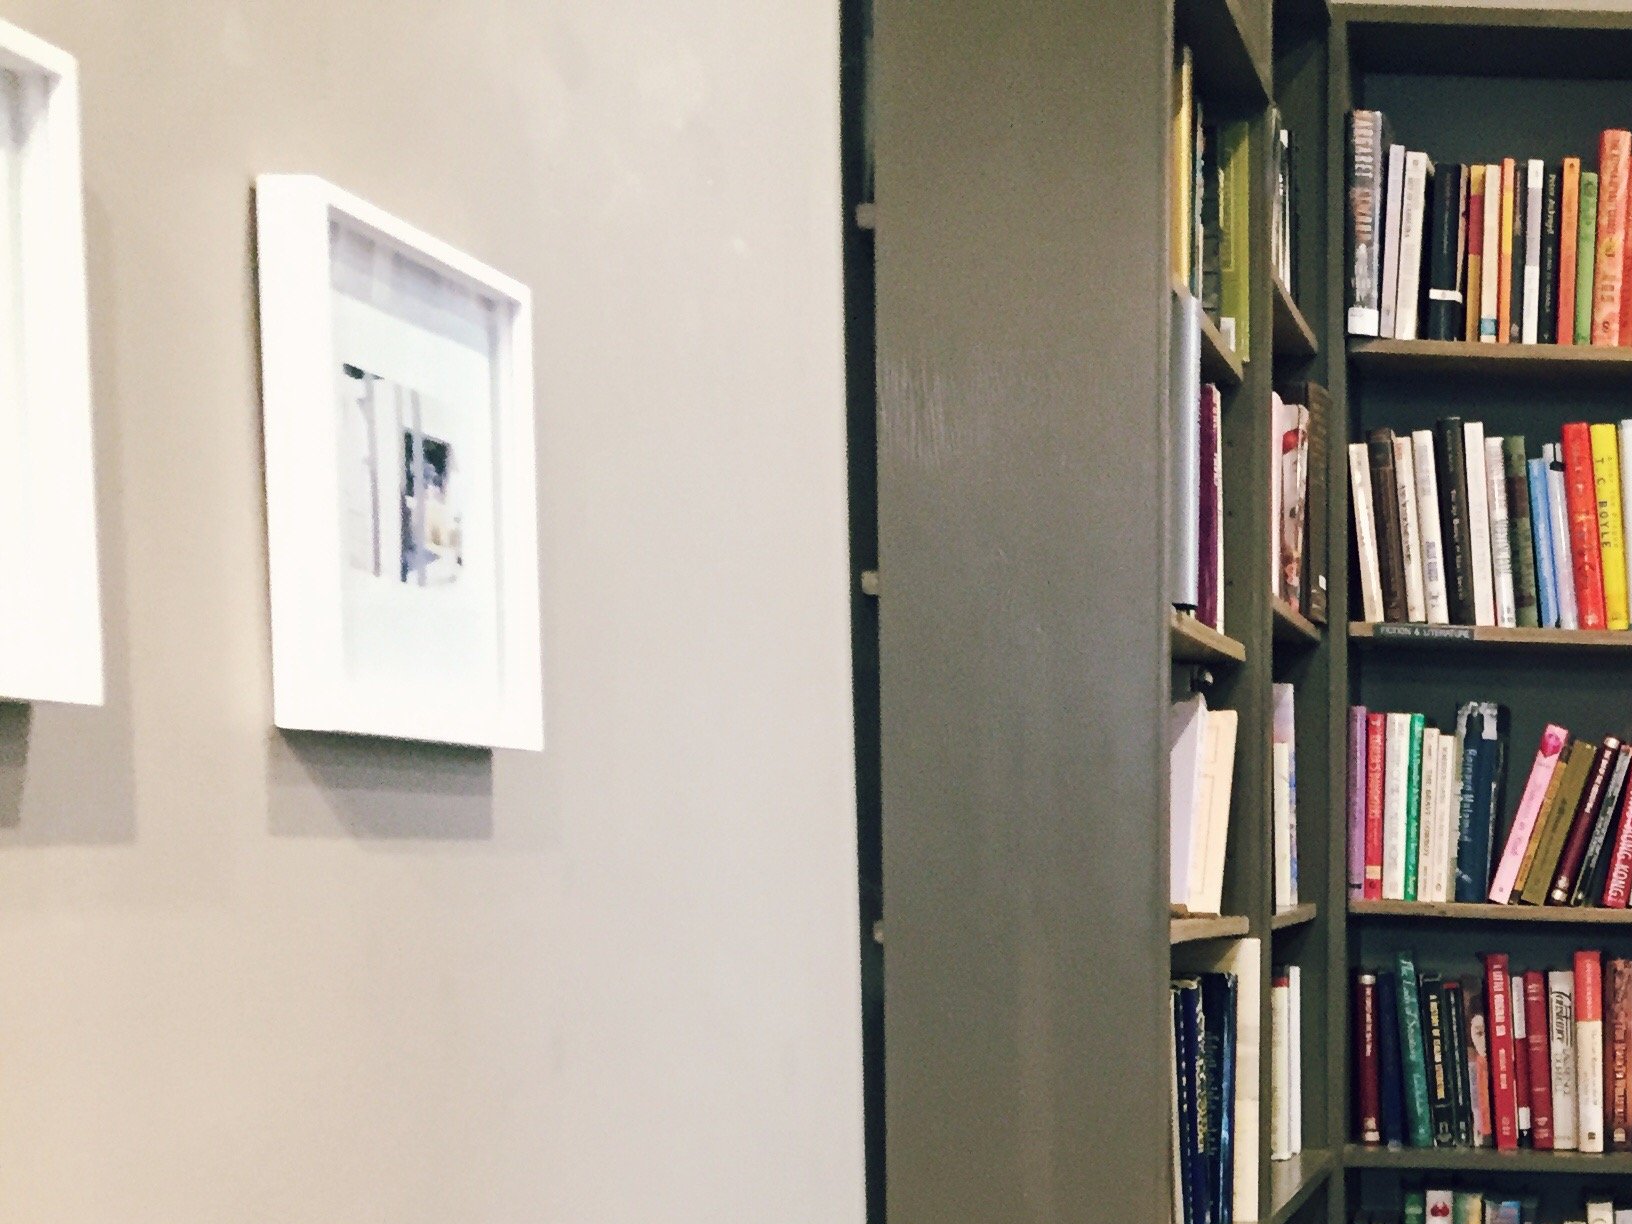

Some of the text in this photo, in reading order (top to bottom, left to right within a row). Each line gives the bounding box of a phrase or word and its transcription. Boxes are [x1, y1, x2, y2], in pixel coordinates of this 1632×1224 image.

[1599, 501, 1611, 548] BOYLE
[1461, 749, 1477, 841] Bernard Malamud
[1608, 864, 1628, 898] KONG
